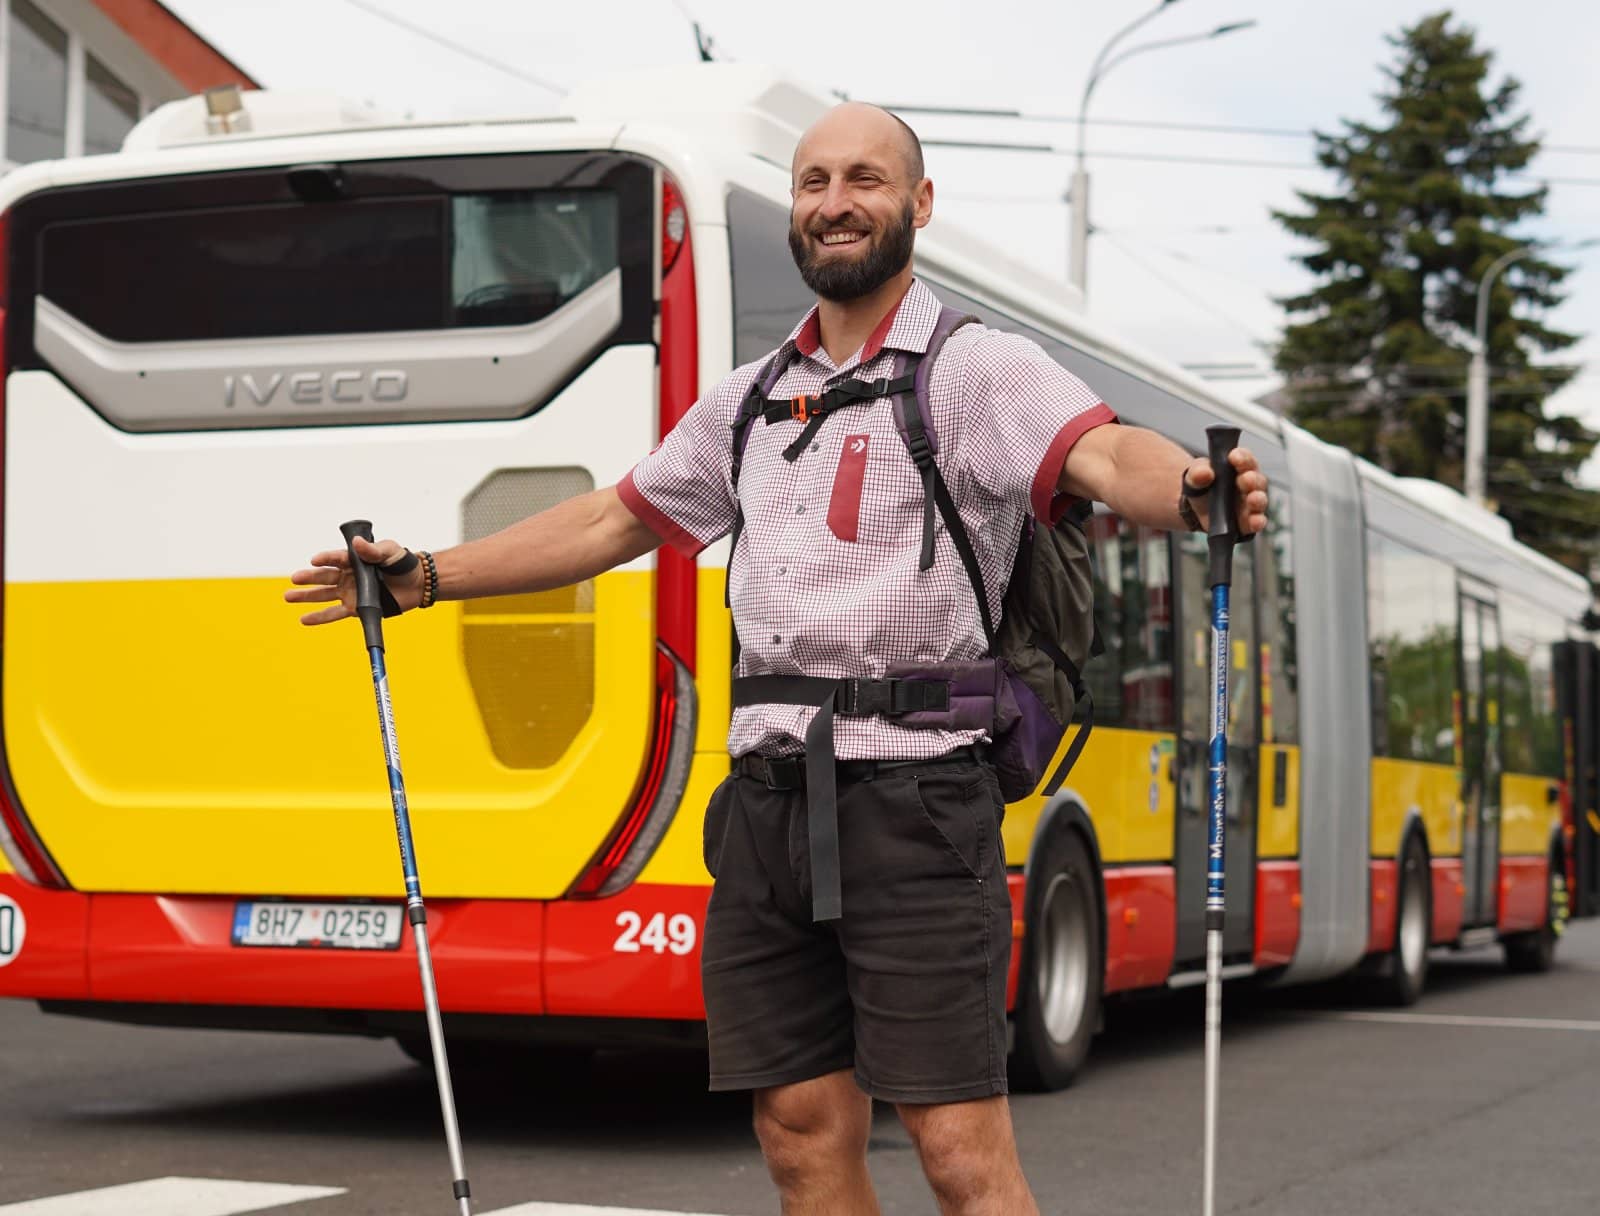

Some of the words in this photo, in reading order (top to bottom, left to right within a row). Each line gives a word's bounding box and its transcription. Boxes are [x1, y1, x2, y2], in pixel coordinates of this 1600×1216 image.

[223, 369, 409, 409] IVECO
[1209, 791, 1225, 858] Mountain
[256, 907, 304, 936] 8H7
[322, 909, 387, 938] 0259
[613, 910, 697, 956] 249
